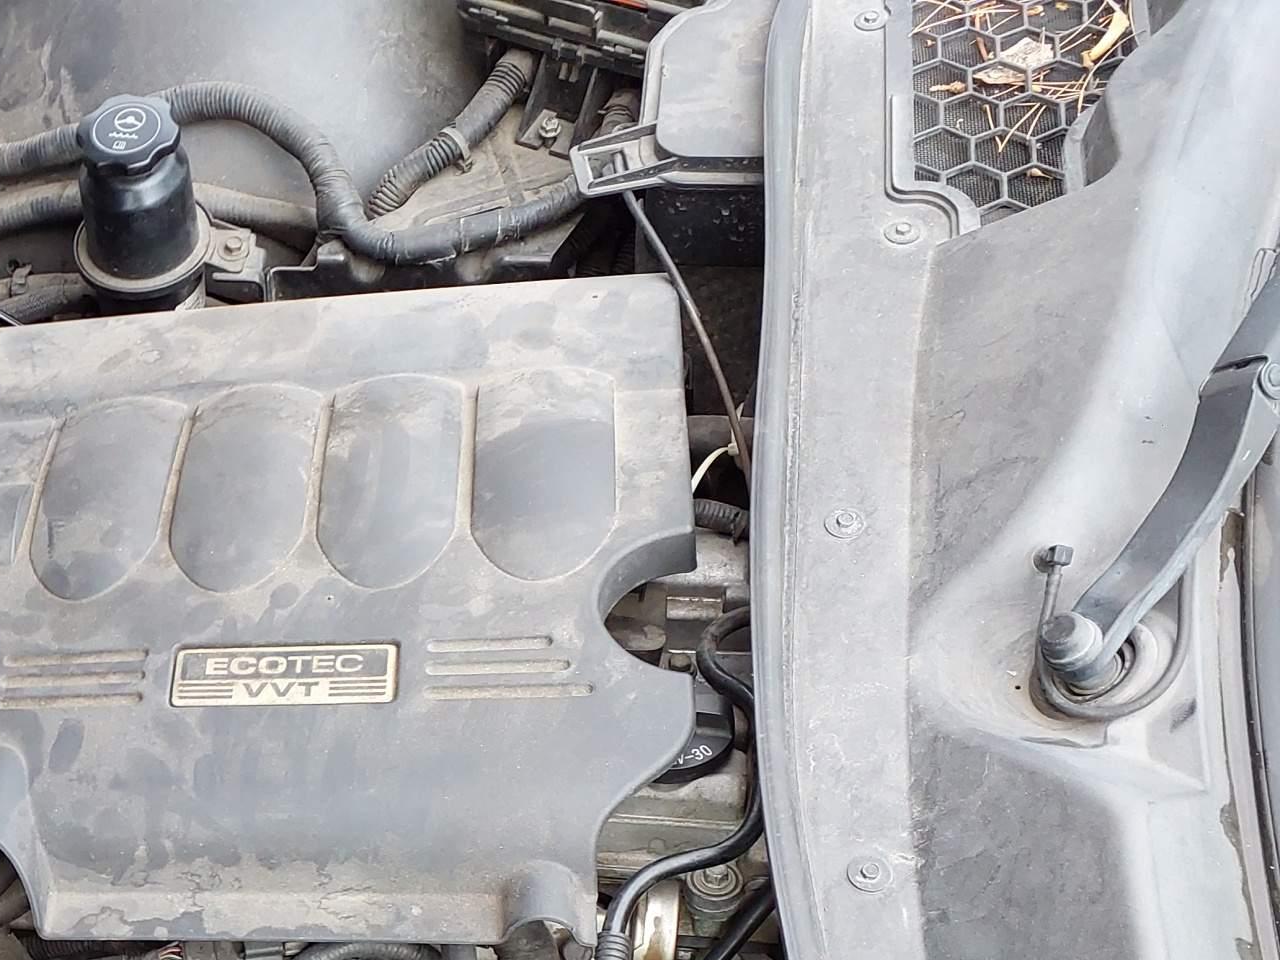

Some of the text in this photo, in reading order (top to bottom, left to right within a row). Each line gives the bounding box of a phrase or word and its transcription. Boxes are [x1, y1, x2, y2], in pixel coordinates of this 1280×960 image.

[205, 654, 364, 676] ECOTEC
[243, 682, 319, 697] VVT
[674, 745, 713, 764] W-30
